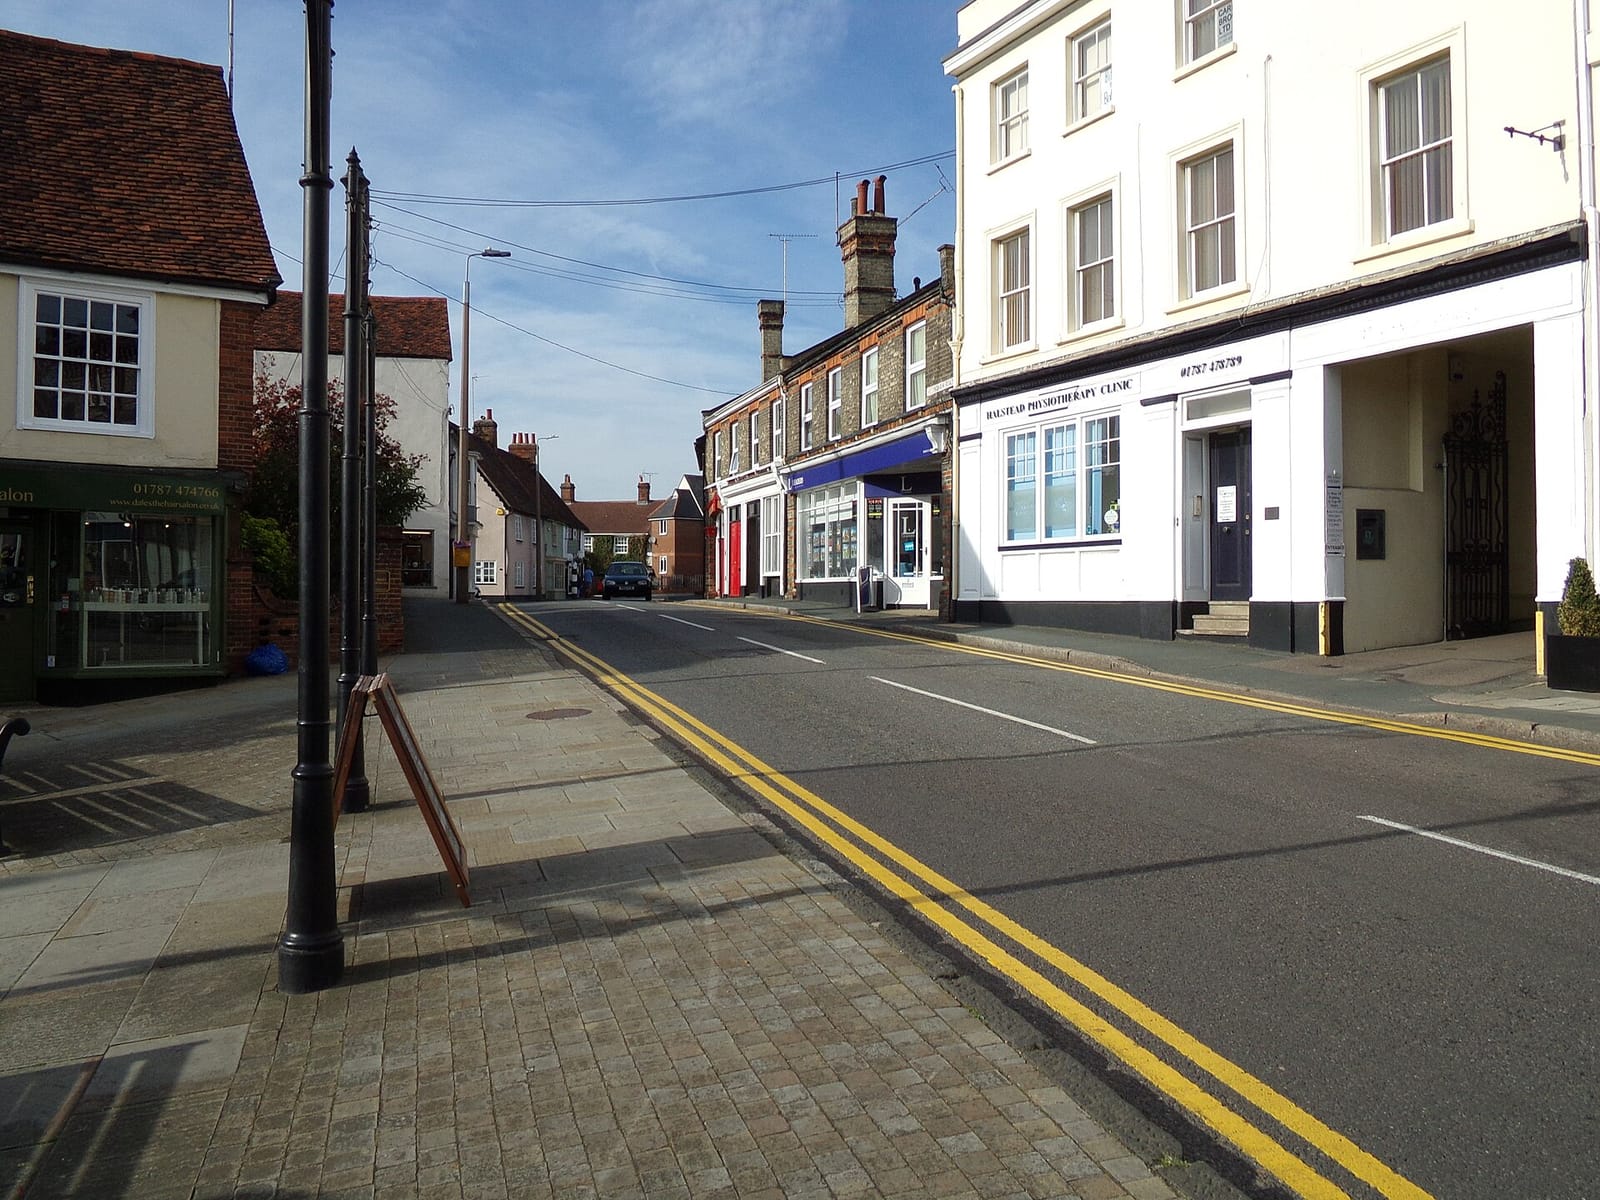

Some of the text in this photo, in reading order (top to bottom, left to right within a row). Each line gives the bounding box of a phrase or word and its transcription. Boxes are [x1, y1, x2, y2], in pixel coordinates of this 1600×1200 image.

[1219, 23, 1231, 35] LTD
[1180, 363, 1207, 378] 01787
[986, 379, 1133, 420] HALSTEAD PHYSIOTHERAPY CLINIC
[133, 483, 219, 497] 01787 474766
